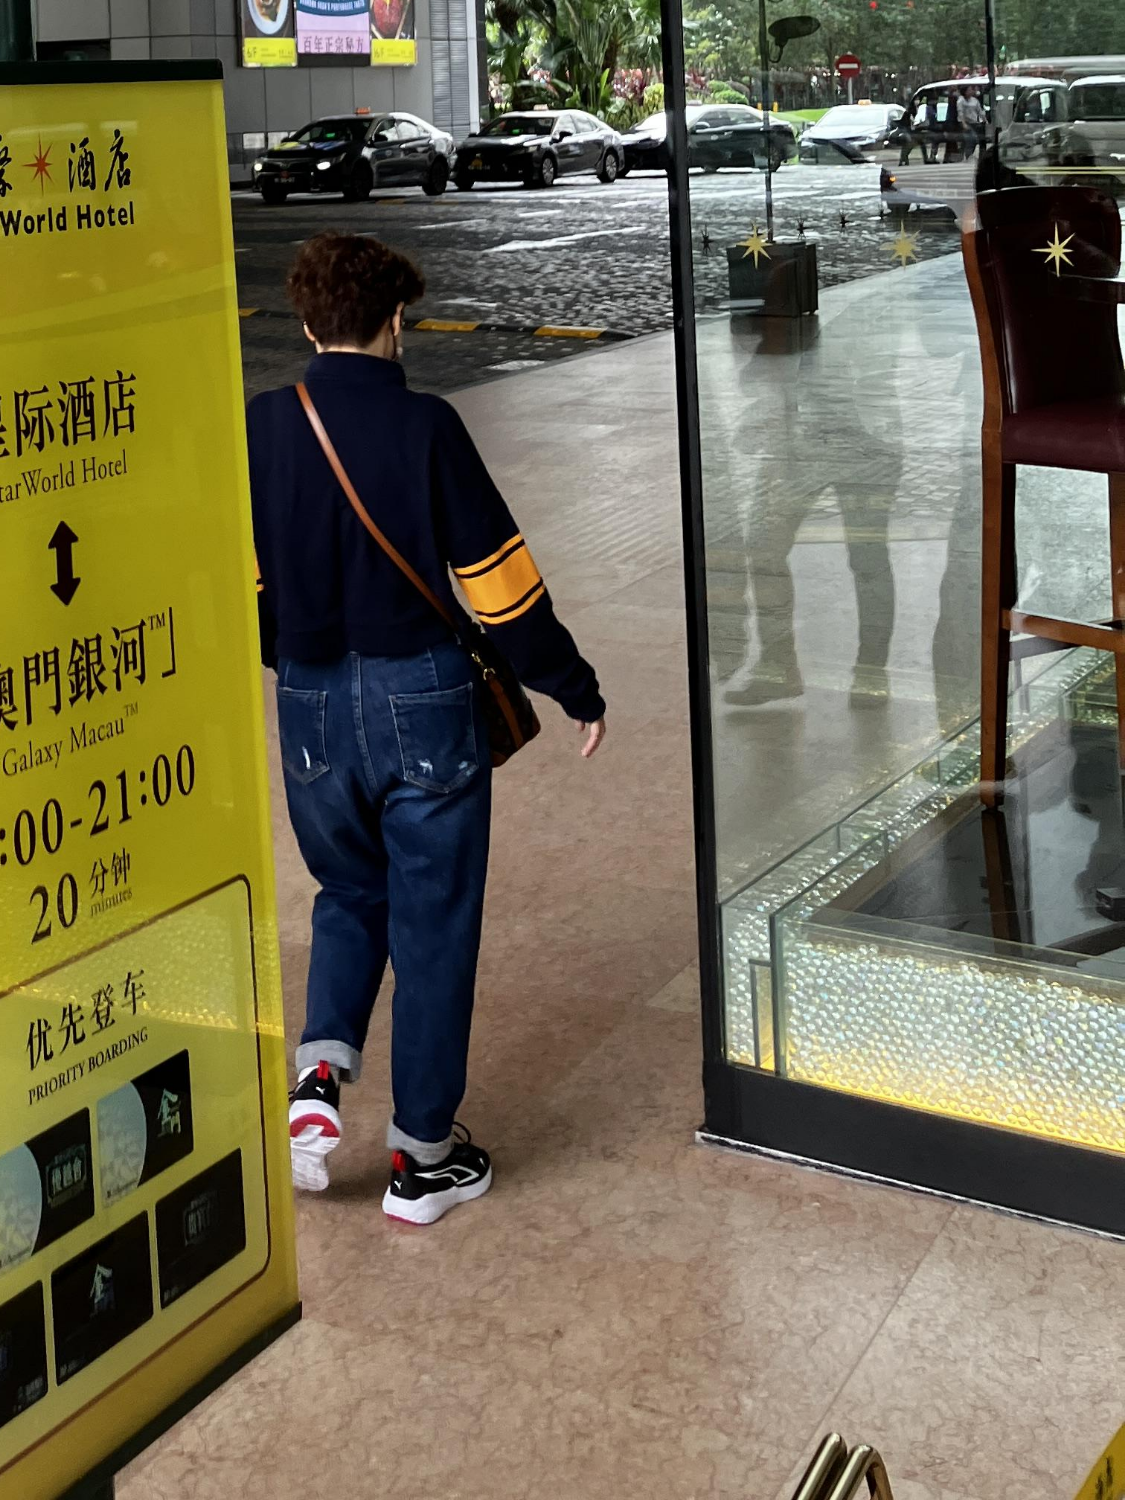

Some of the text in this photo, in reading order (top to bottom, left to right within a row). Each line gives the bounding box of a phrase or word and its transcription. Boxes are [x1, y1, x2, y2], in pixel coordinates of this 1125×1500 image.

[76, 201, 135, 231] Hotel
[81, 448, 128, 484] Hotel
[2, 740, 63, 777] Galaxy
[89, 848, 131, 898] 分钟
[29, 872, 79, 945] 20
[89, 887, 133, 918] minutes
[26, 969, 147, 1072] 优先登车
[28, 1027, 148, 1106] PRIORITY BOARDING
